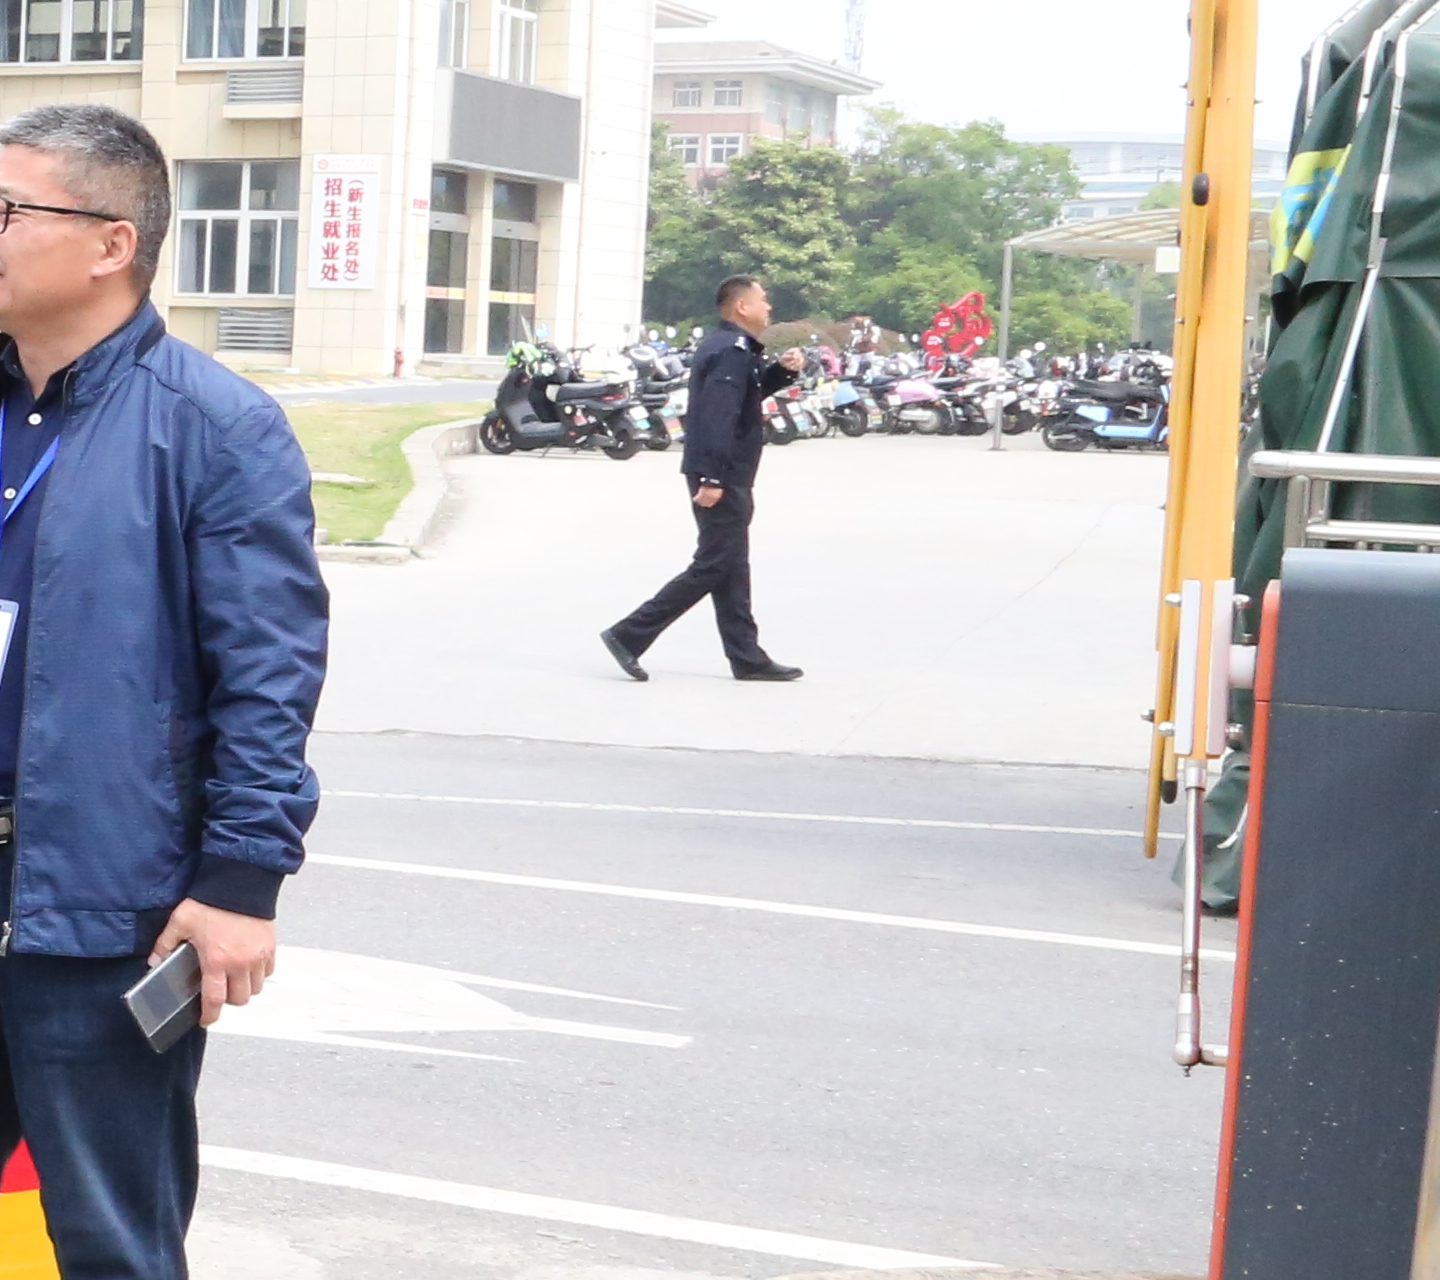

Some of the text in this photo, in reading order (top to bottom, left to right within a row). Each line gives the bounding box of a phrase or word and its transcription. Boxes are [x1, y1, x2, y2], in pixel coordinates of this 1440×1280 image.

[321, 178, 342, 281] 招生就业处
